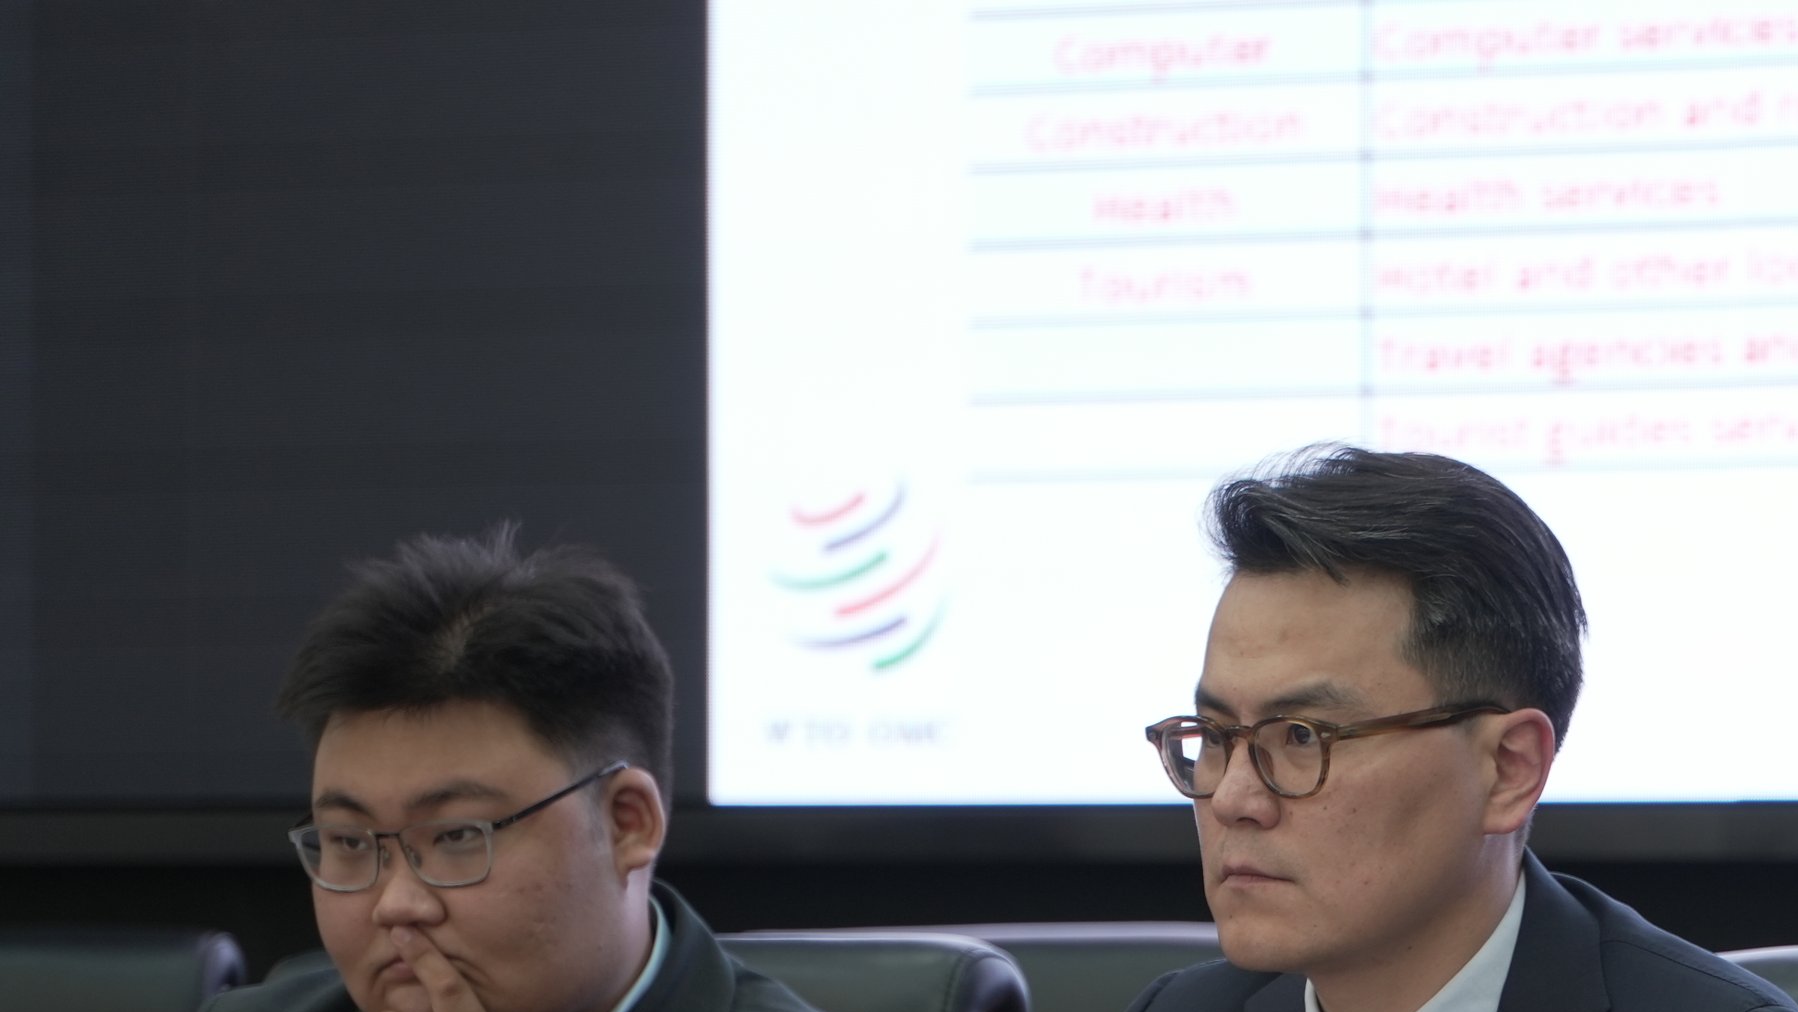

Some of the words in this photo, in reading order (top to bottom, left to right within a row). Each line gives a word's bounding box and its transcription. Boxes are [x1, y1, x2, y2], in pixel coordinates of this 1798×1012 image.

[1053, 34, 1272, 84] Computer
[1374, 22, 1599, 73] Computer
[1025, 108, 1304, 152] Construction
[1374, 98, 1664, 140] Construction
[1684, 88, 1762, 128] and
[1093, 186, 1237, 223] Health
[1374, 179, 1523, 216] Health
[1542, 178, 1719, 212] services
[1080, 266, 1252, 304] Tourism
[1376, 260, 1494, 294] Hotel
[1516, 255, 1595, 293] and
[1612, 250, 1729, 289] other
[1378, 336, 1510, 373] Travel
[1531, 332, 1723, 386] agencies
